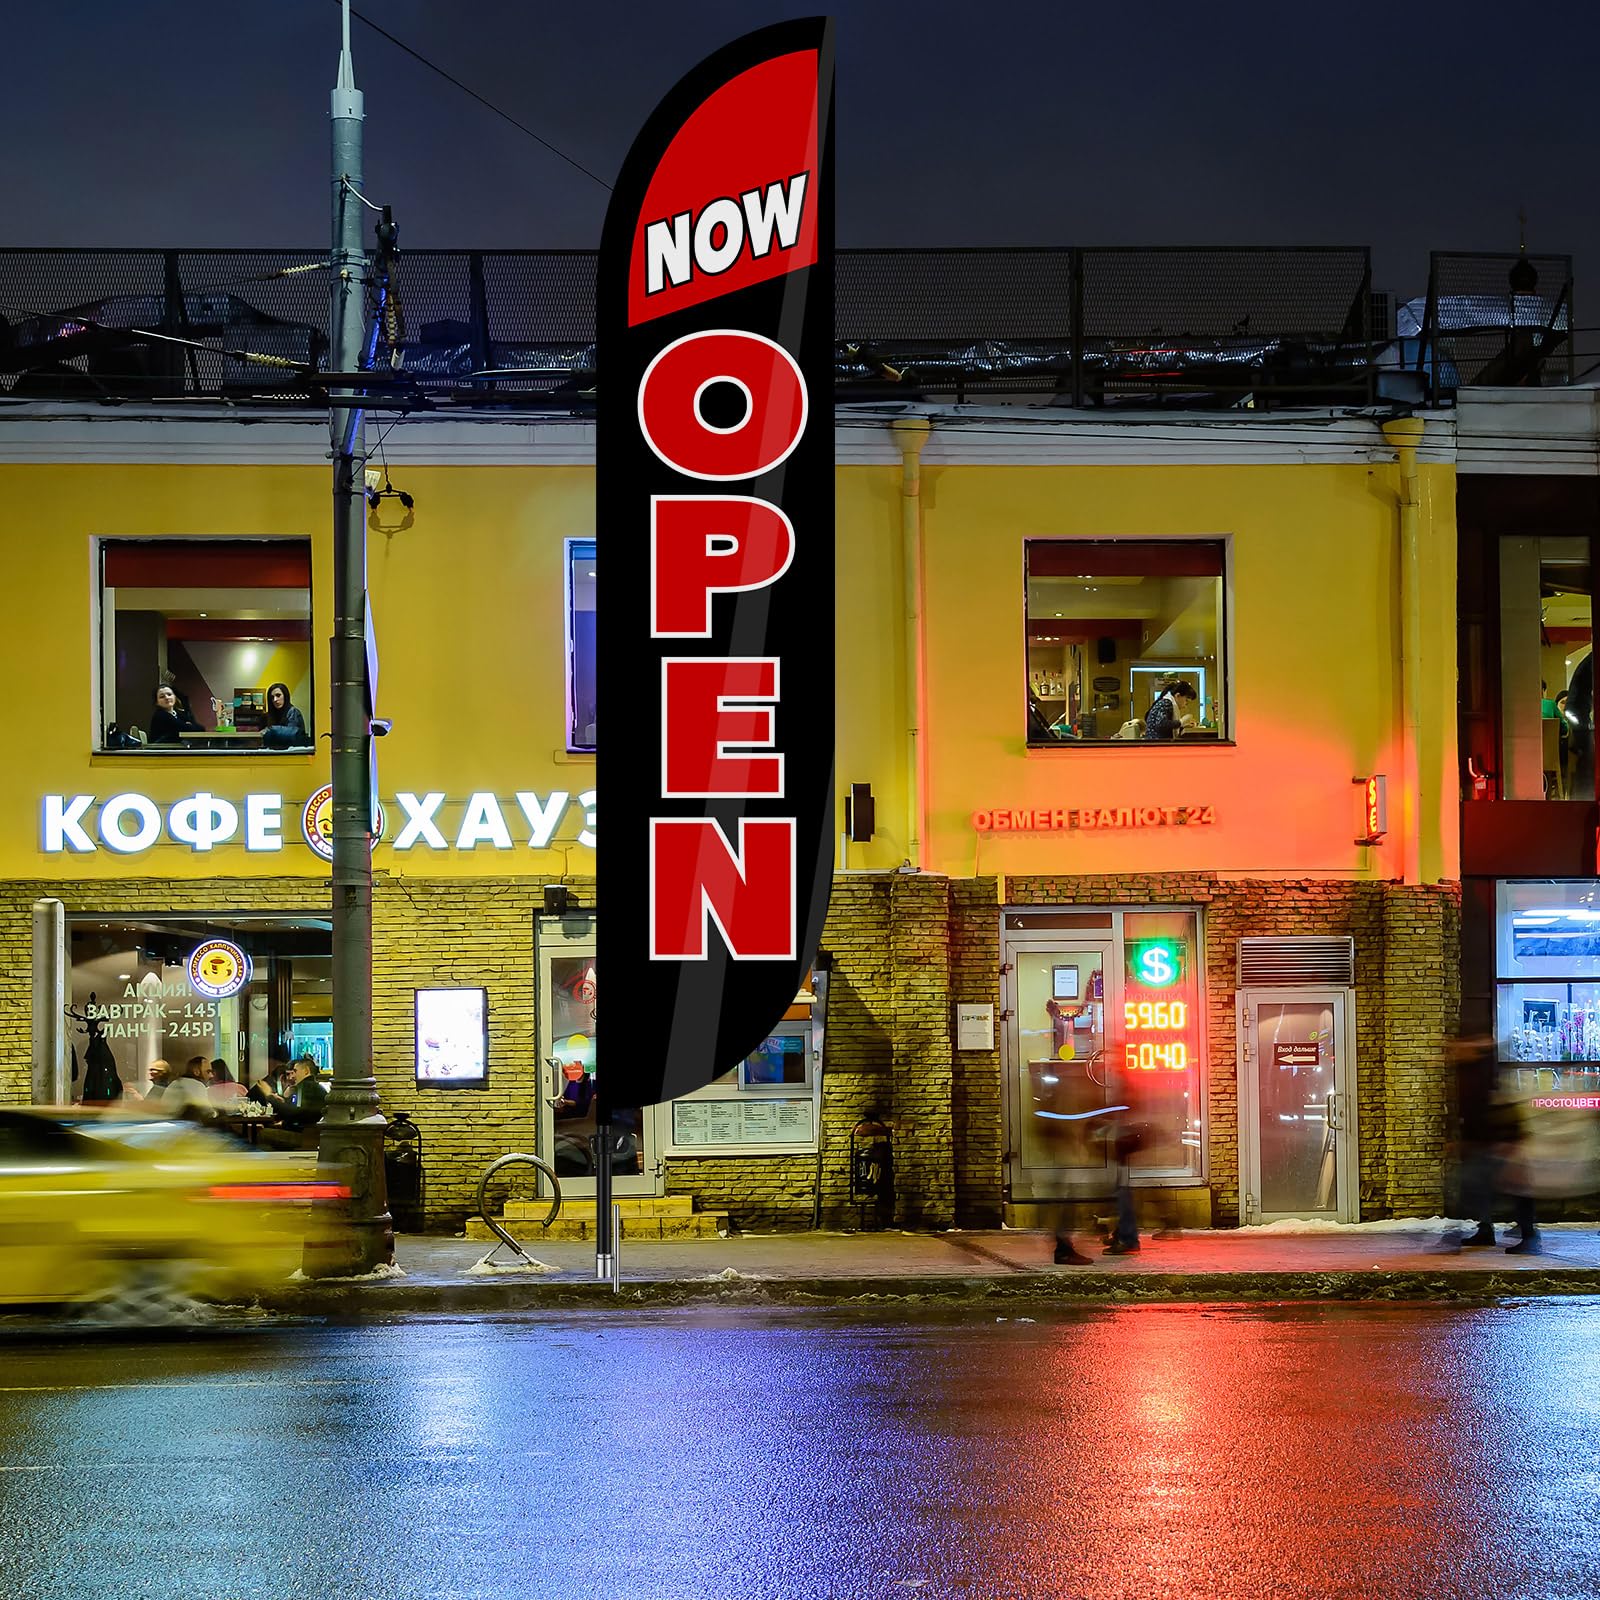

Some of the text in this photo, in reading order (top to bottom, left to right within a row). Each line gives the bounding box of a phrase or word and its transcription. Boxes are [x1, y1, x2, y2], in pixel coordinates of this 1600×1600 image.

[645, 170, 810, 297] NOW
[637, 329, 809, 961] OPEN
[43, 792, 283, 853] КОФЕ
[972, 806, 1217, 831] ОБМЕН ВАЛЮТ 24
[123, 982, 193, 999] АКЦИЯ!
